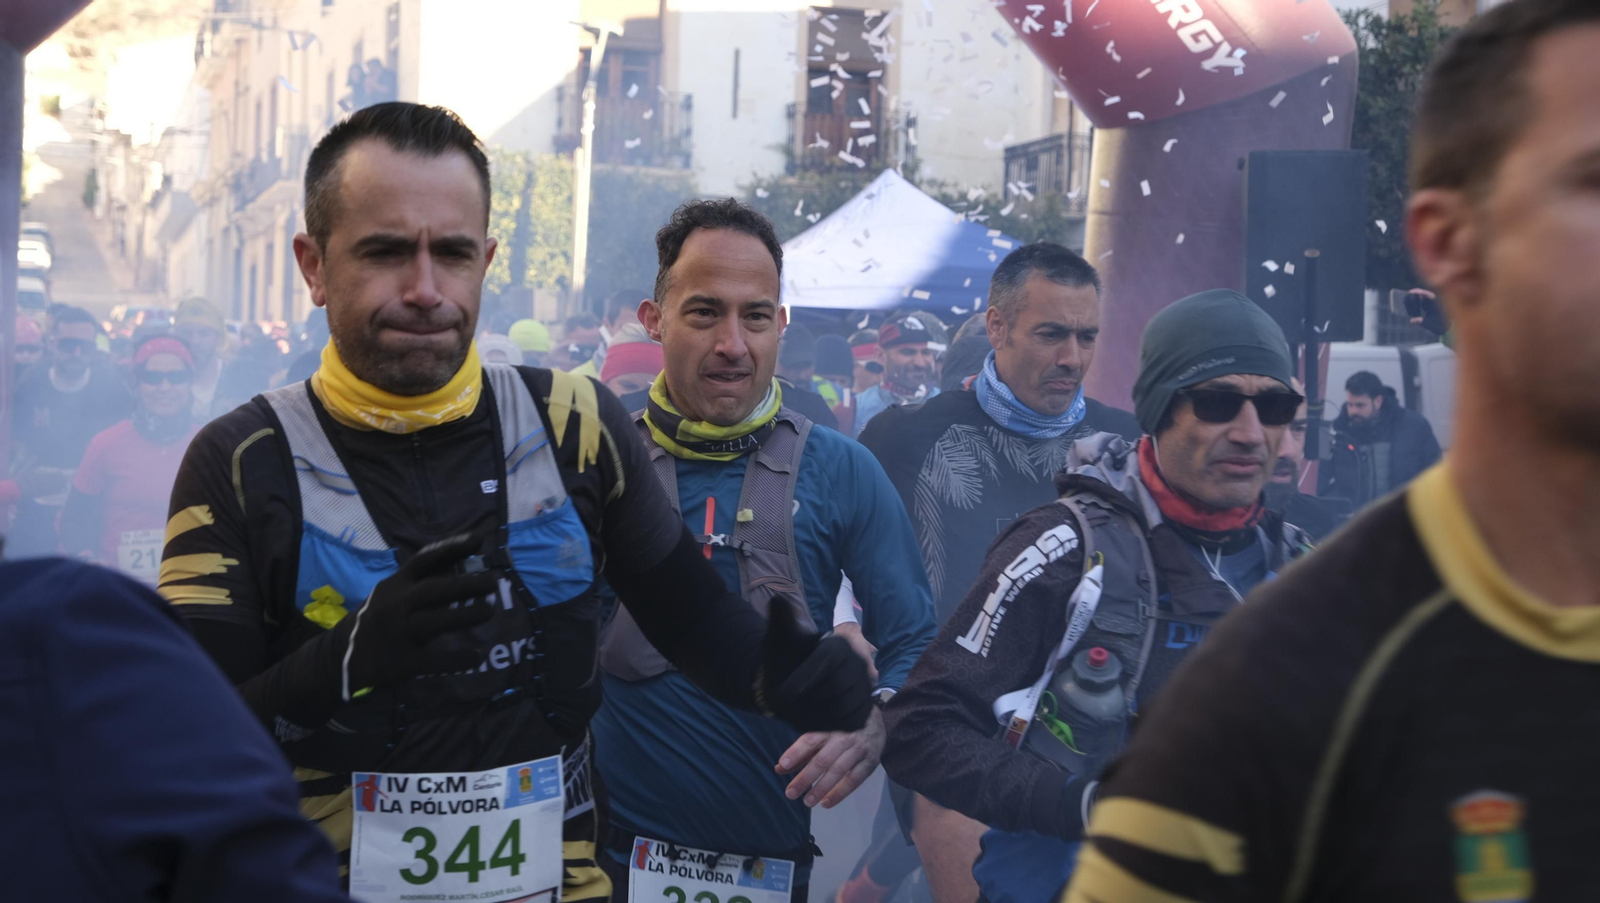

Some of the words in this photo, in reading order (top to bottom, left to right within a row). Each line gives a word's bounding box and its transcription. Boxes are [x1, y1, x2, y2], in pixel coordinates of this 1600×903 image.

[1149, 0, 1246, 71] RGY
[387, 776, 410, 793] IV
[417, 775, 467, 794] CxM
[380, 799, 403, 814] LA
[410, 796, 500, 815] PÓLVORA
[398, 818, 527, 886] 344
[648, 860, 665, 875] LA
[669, 863, 735, 886] PÓLVORA
